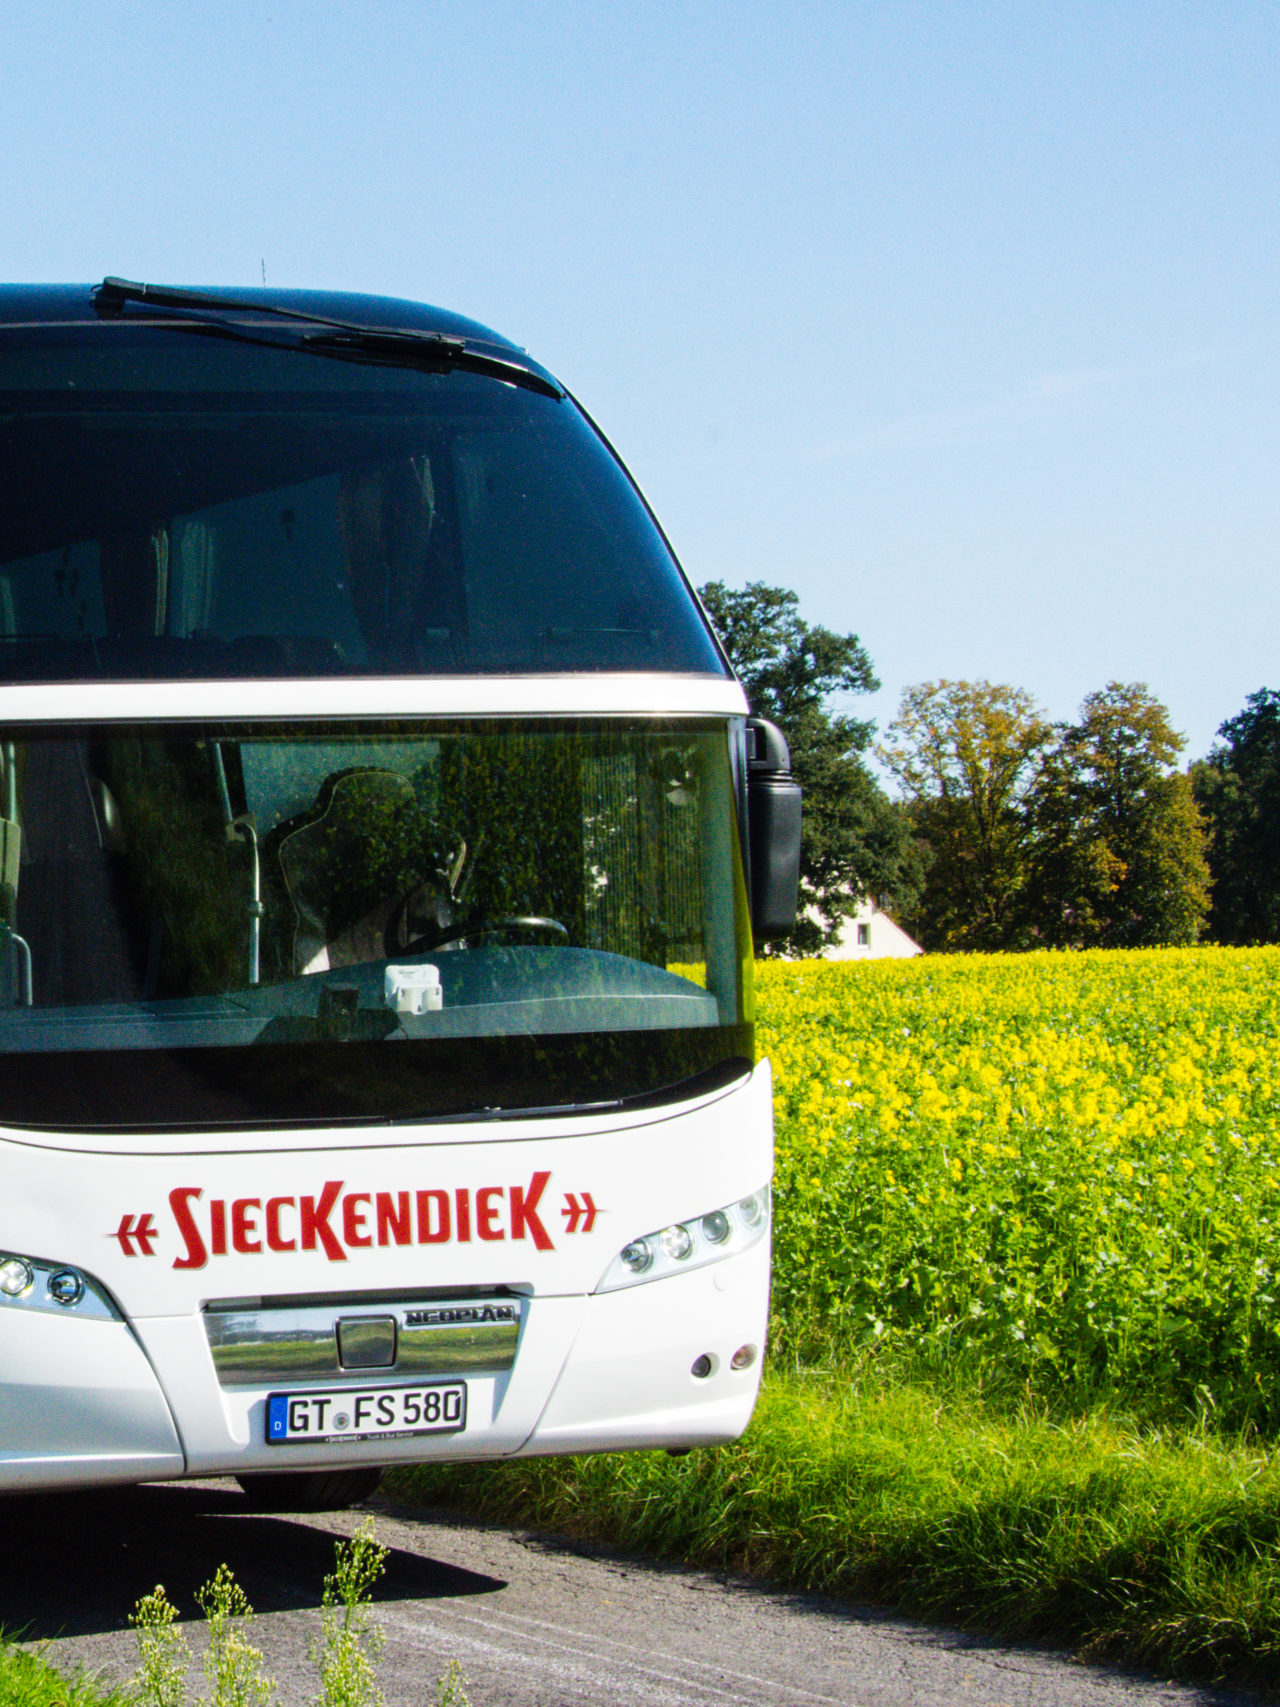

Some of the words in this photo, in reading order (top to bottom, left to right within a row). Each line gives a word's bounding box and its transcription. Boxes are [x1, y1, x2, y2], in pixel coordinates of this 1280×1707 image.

[168, 1171, 556, 1271] SIECKENDIEK
[405, 1304, 513, 1324] NEOPLAN
[274, 1421, 282, 1431] D
[289, 1399, 331, 1432] GT
[355, 1395, 396, 1428] FS
[403, 1390, 462, 1425] 580
